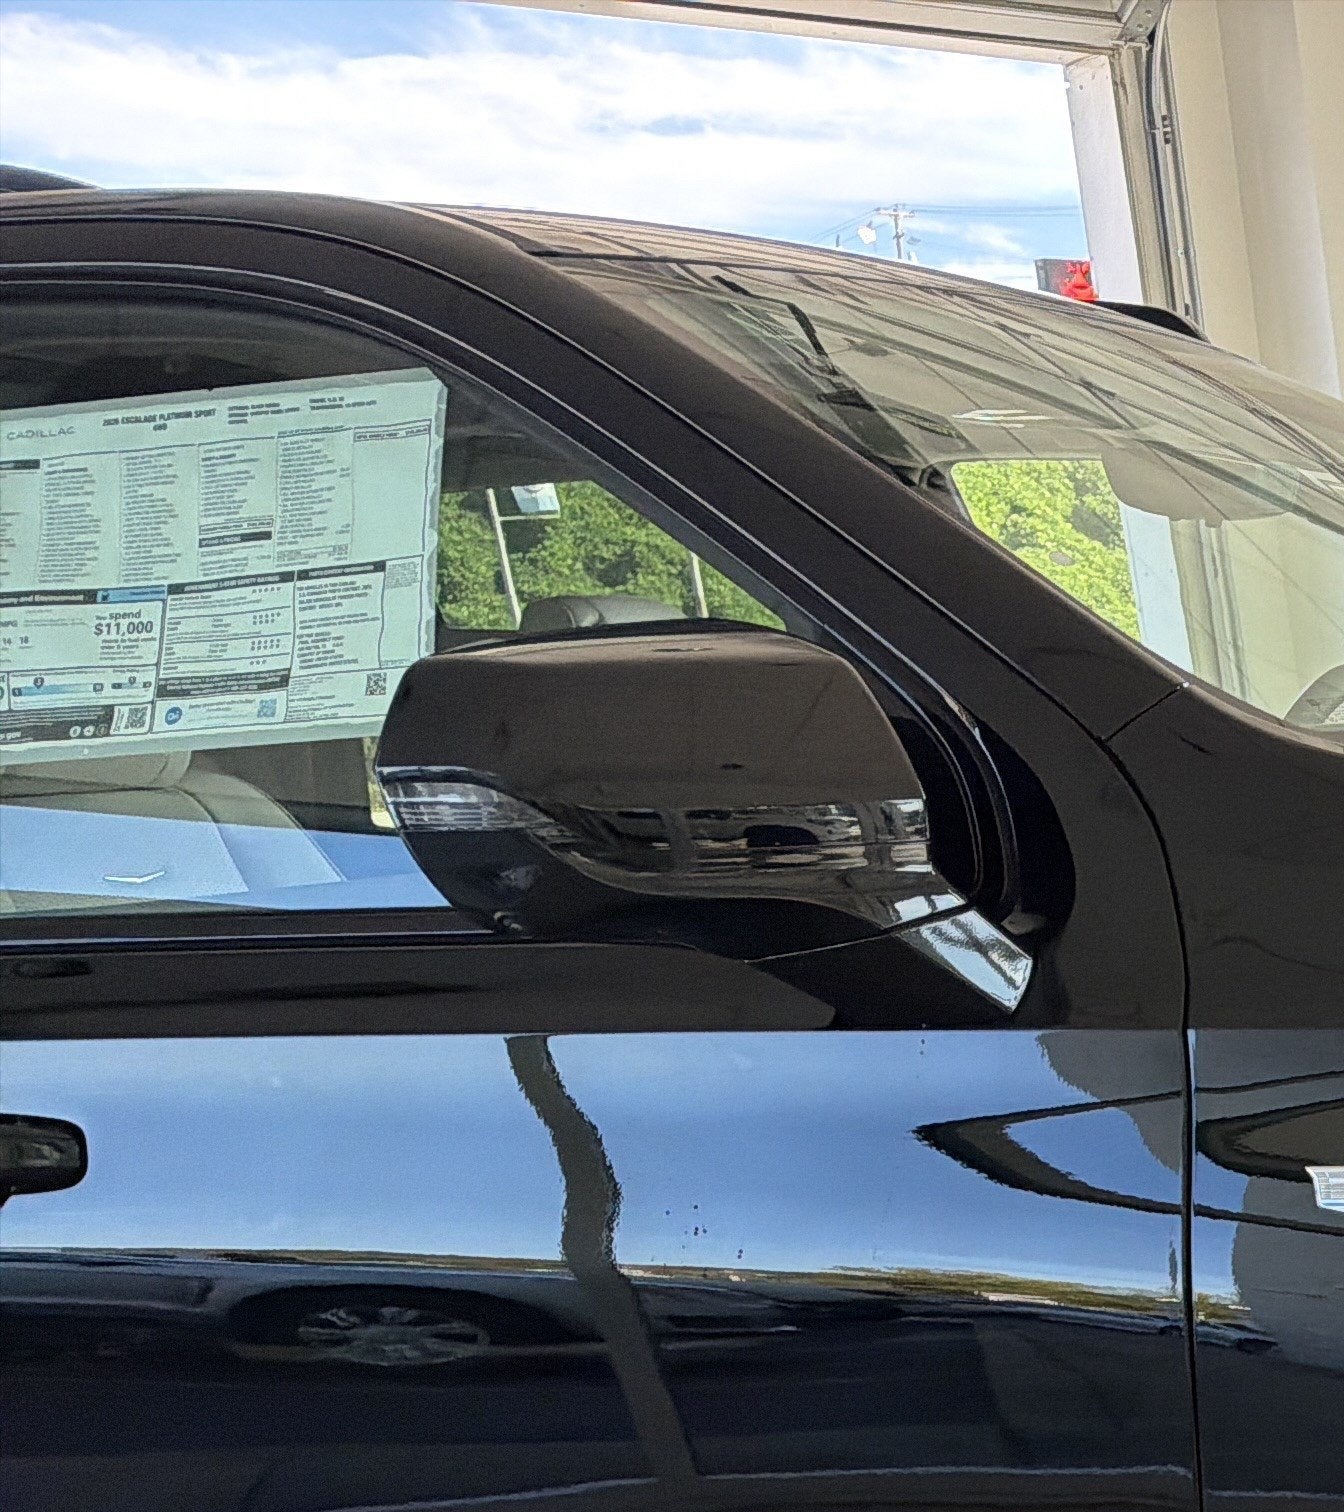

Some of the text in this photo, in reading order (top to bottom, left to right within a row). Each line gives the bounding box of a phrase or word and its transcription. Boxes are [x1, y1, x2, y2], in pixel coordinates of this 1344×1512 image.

[121, 414, 157, 425] ESCALADE
[194, 408, 217, 418] SPORT
[7, 426, 75, 440] CADILLAC
[109, 609, 142, 622] spend
[93, 620, 154, 637] $11,000
